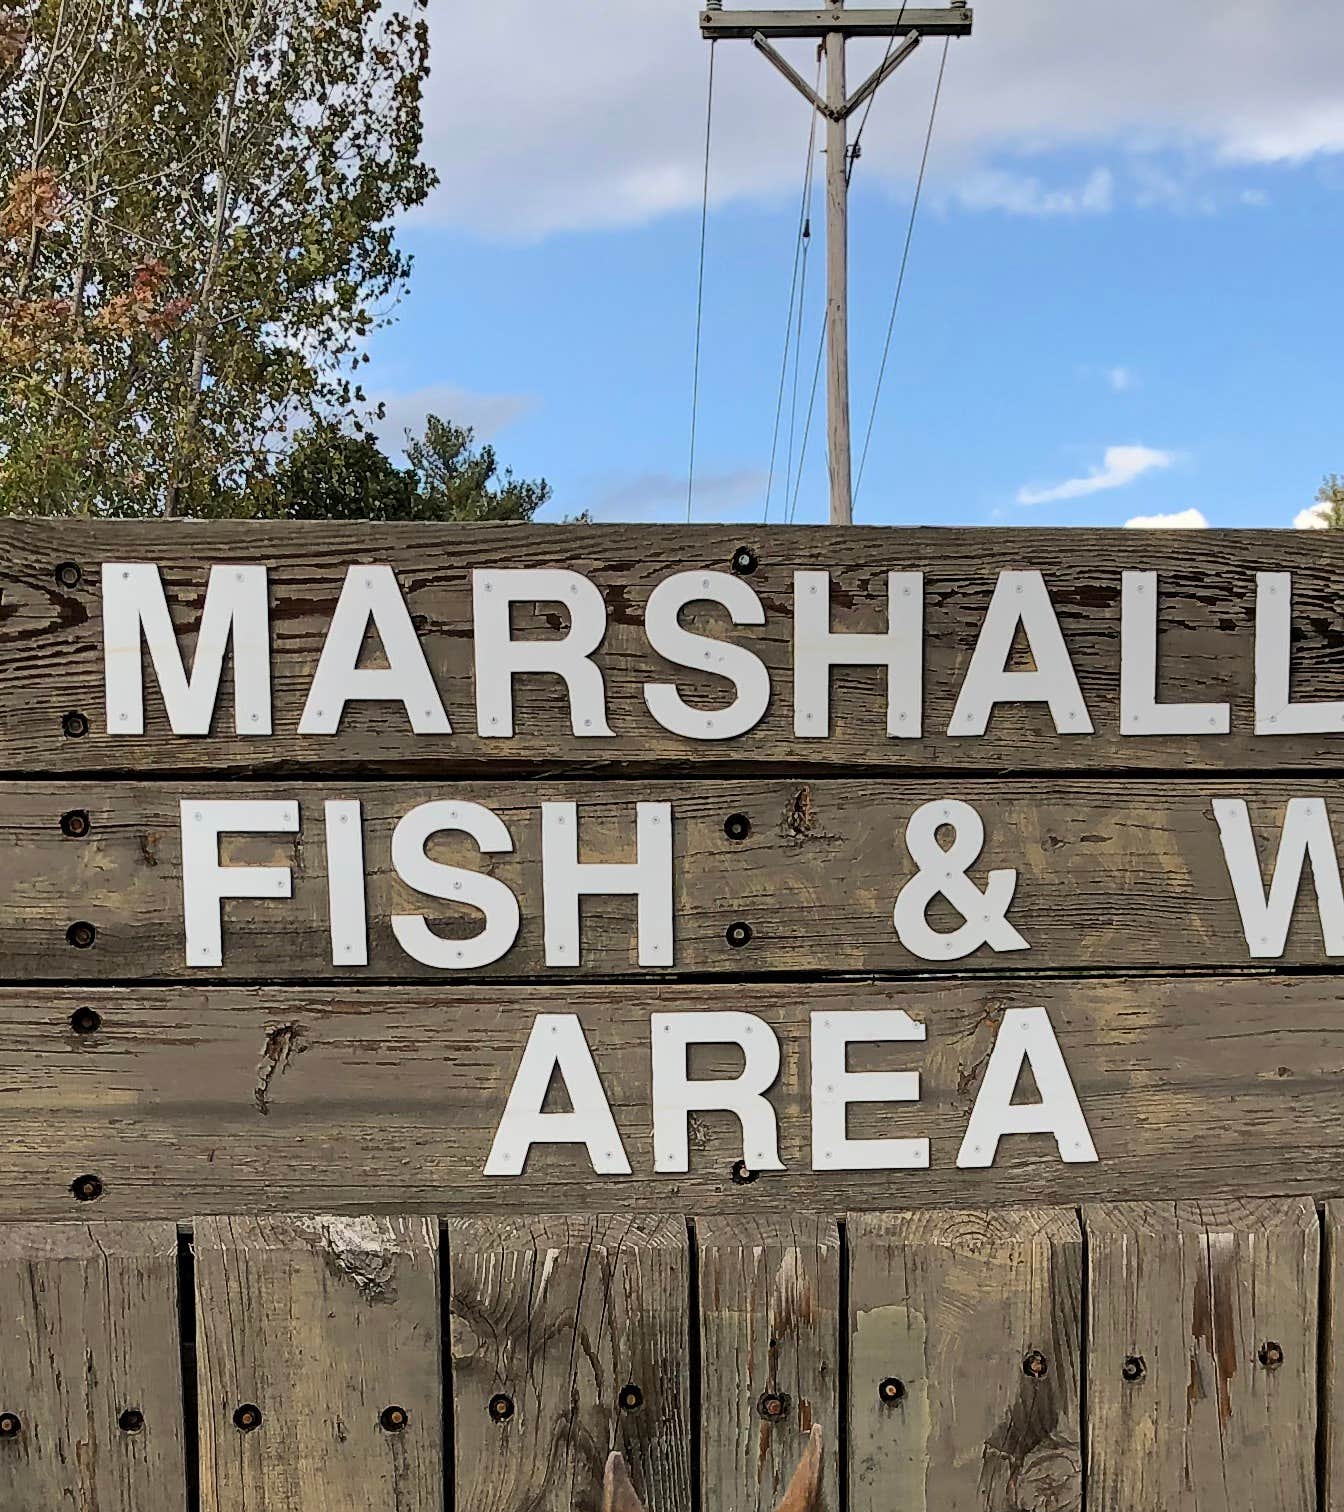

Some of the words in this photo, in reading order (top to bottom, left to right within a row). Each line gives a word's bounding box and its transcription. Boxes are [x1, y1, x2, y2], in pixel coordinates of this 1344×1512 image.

[179, 798, 674, 969] FISH
[893, 799, 1031, 961] &
[481, 1005, 1100, 1178] AREA
